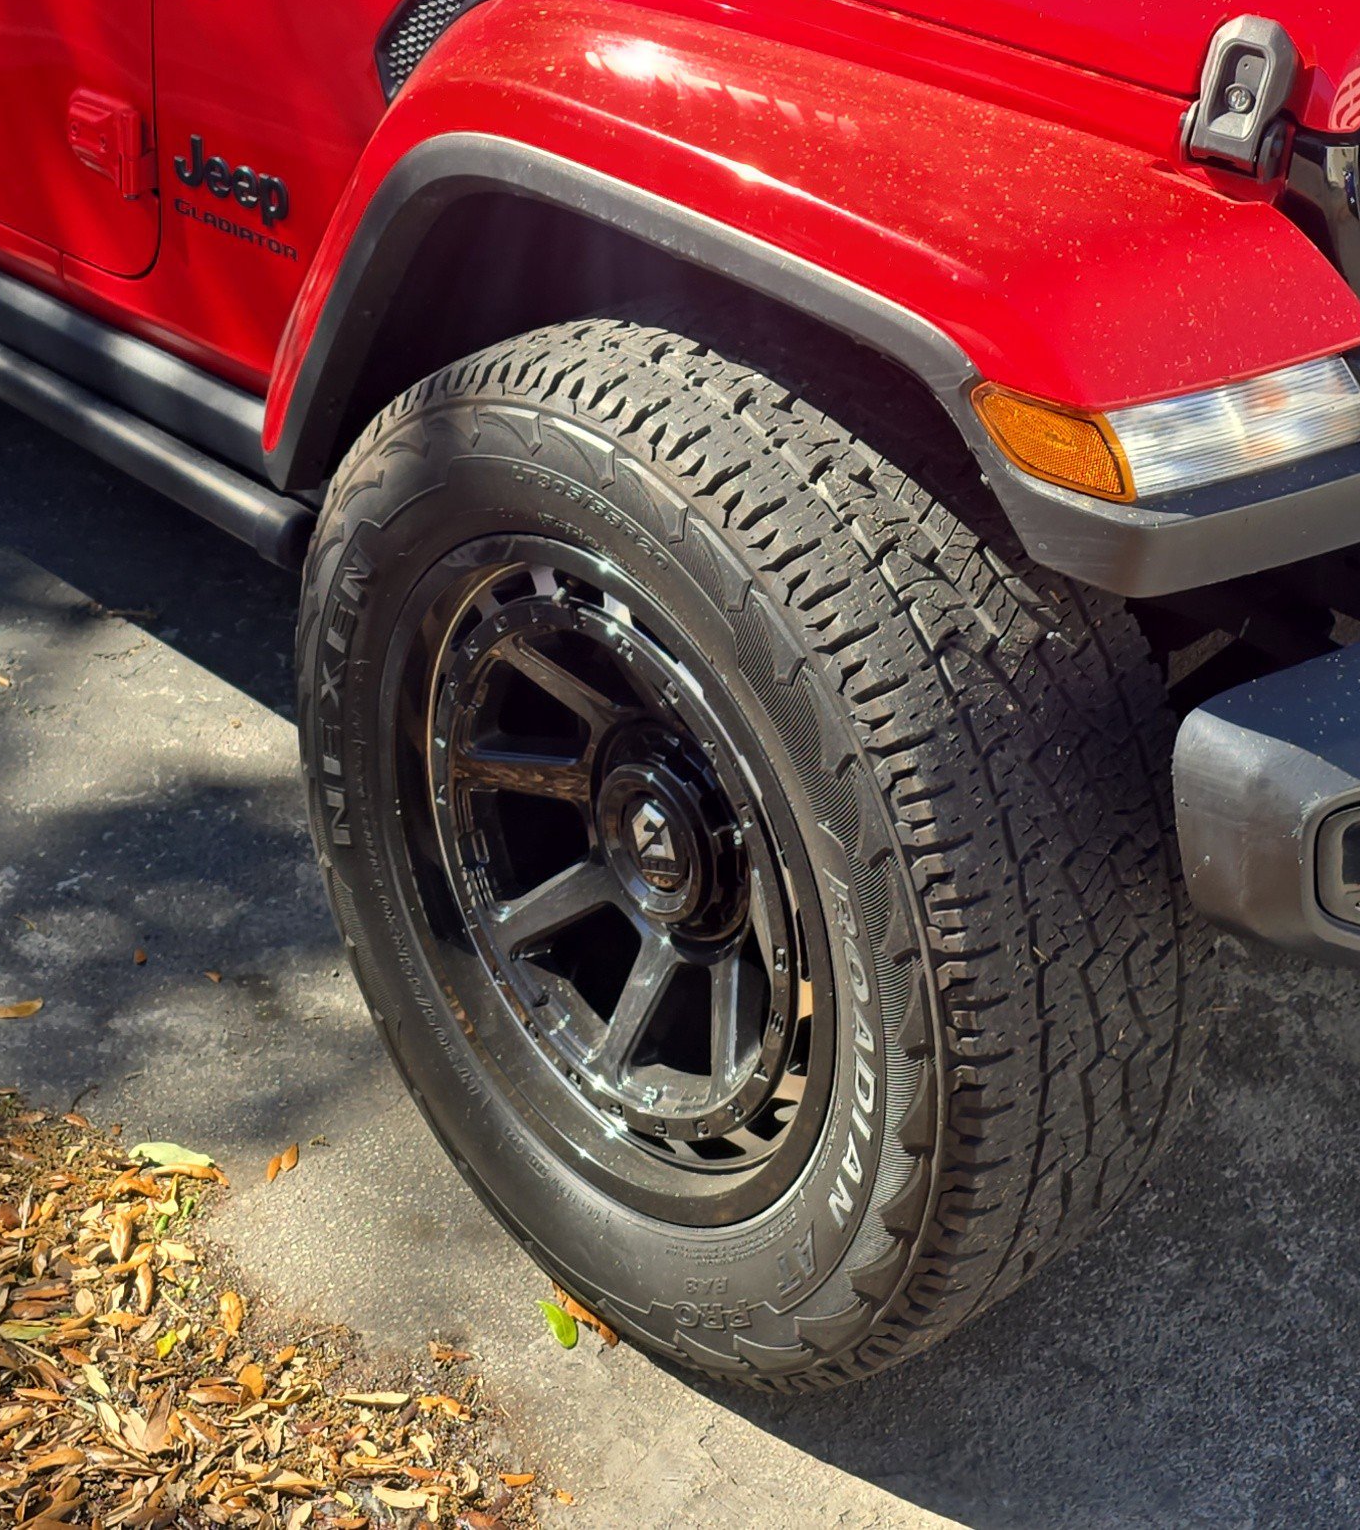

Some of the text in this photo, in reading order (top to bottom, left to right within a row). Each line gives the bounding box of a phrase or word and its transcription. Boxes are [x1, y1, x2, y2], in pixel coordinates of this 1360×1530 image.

[174, 134, 289, 227] Jeep
[174, 198, 298, 262] GLADIATOR
[319, 543, 377, 846] NEXEN
[822, 867, 878, 1229] ROADIAN
[777, 1220, 817, 1298] AT
[673, 1299, 752, 1330] PRO
